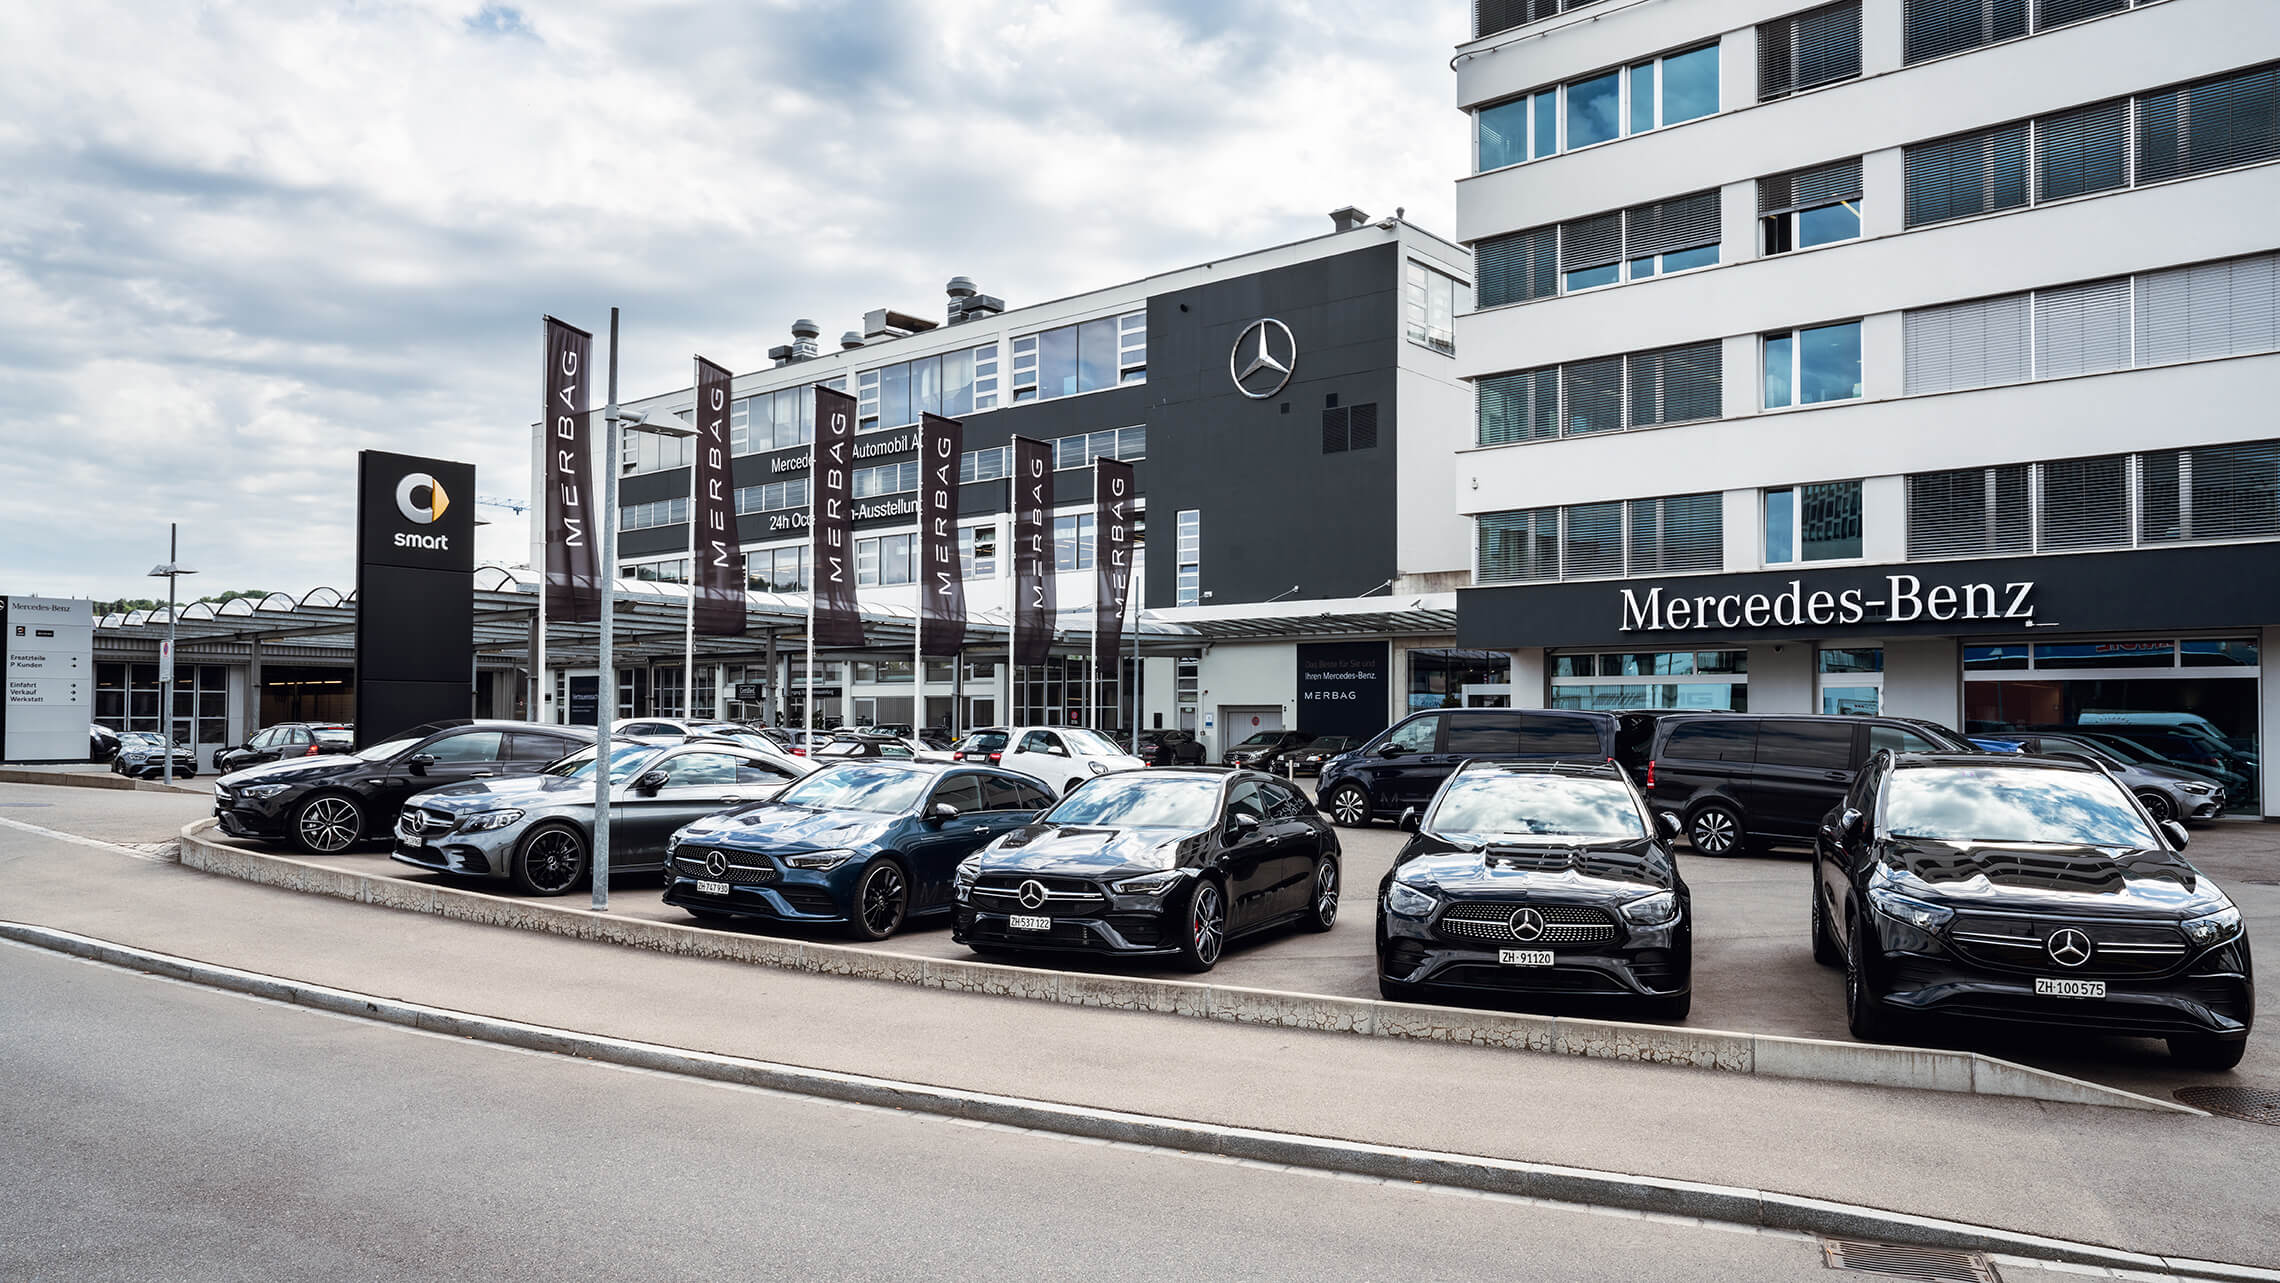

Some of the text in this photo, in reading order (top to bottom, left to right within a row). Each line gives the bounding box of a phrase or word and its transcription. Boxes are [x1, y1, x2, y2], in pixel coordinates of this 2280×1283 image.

[558, 351, 583, 546] MERBAG
[852, 435, 908, 459] Automobil
[709, 388, 729, 567] MERBAG
[827, 413, 847, 582] MERBAG
[770, 515, 789, 530] 24h
[935, 437, 953, 595] MERBAG
[394, 533, 448, 550] smart
[1032, 459, 1043, 608] MERBAG
[1112, 478, 1126, 618] MERBAG
[12, 603, 71, 612] Mercedes-Benz
[1619, 575, 2035, 631] Mercedes-Benz
[1304, 672, 1322, 680] Ihren
[1304, 691, 1357, 700] MERBAG
[1036, 919, 1049, 928] 122
[2080, 983, 2104, 996] 575
